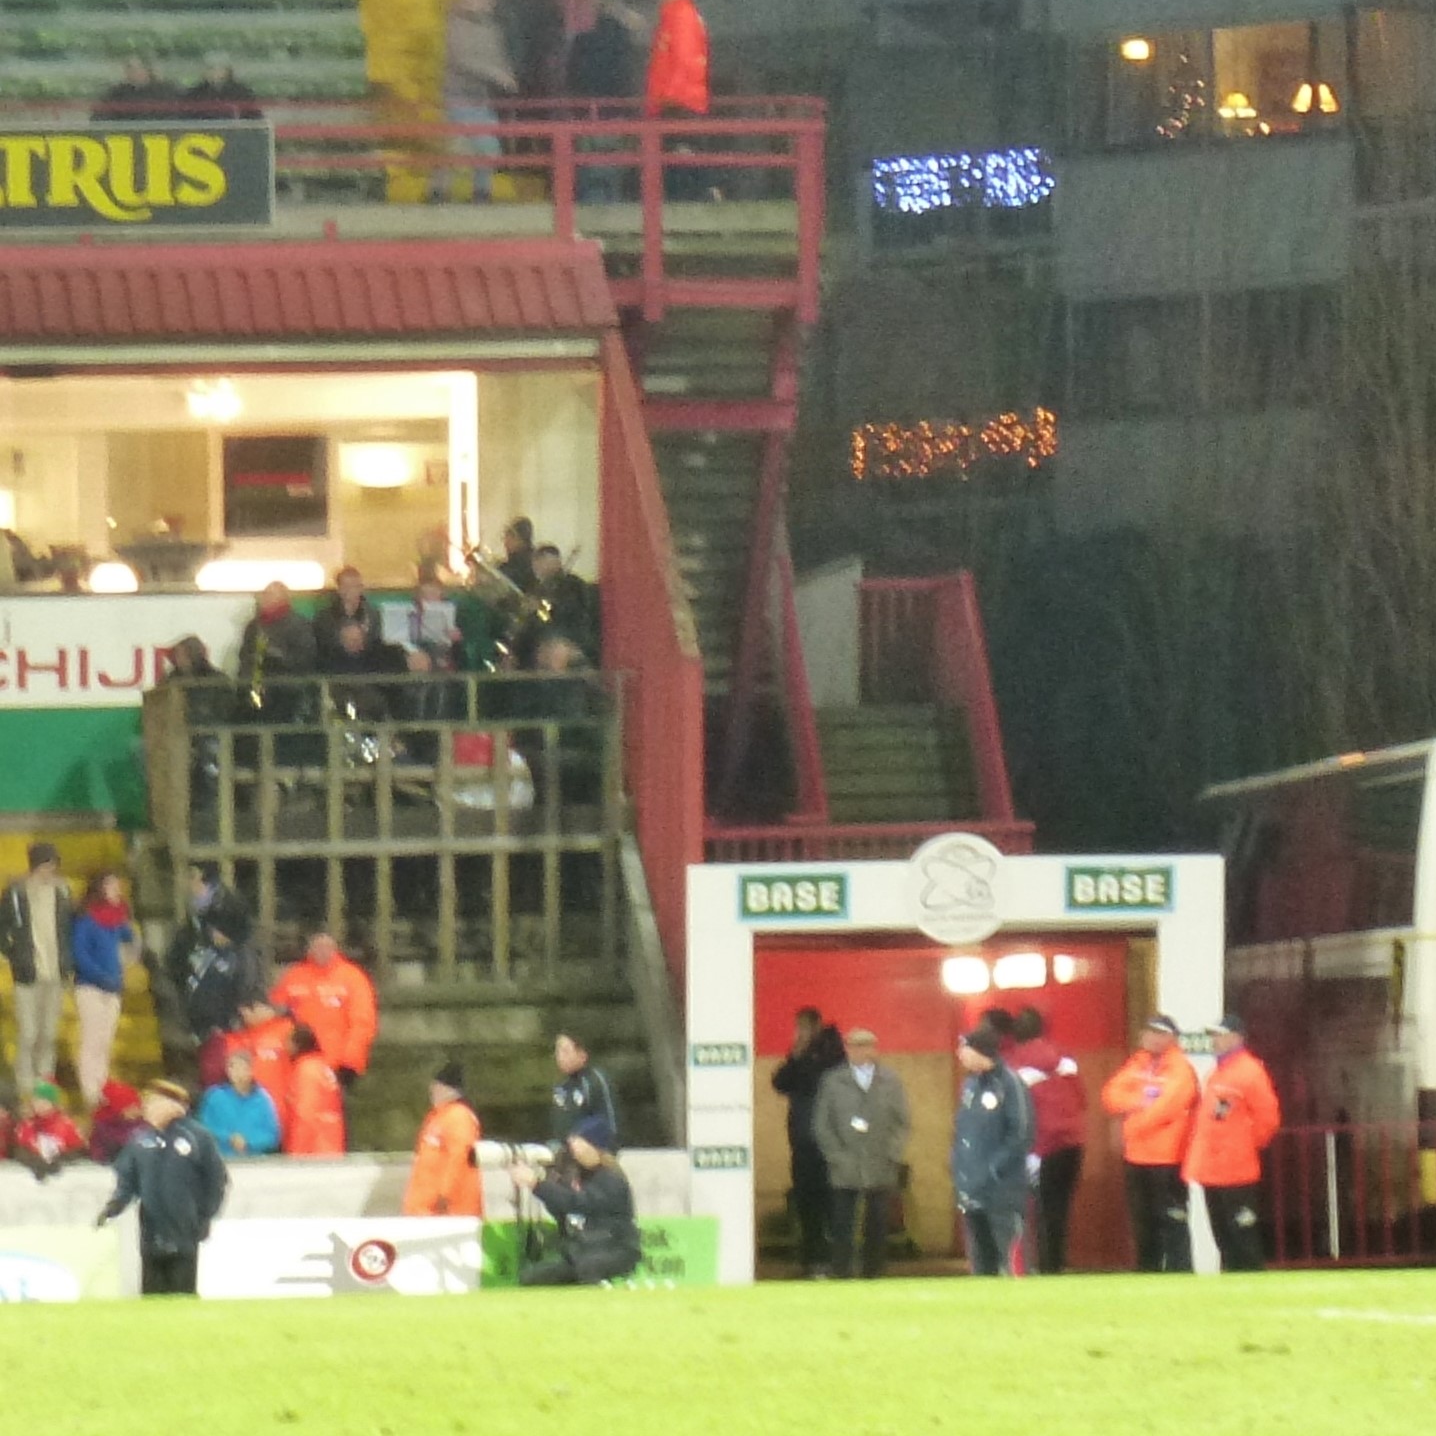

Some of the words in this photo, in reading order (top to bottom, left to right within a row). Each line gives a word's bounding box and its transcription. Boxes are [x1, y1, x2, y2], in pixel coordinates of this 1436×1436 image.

[0, 133, 228, 222] TRUS
[746, 880, 839, 913] BASE
[1073, 872, 1166, 904] BASE
